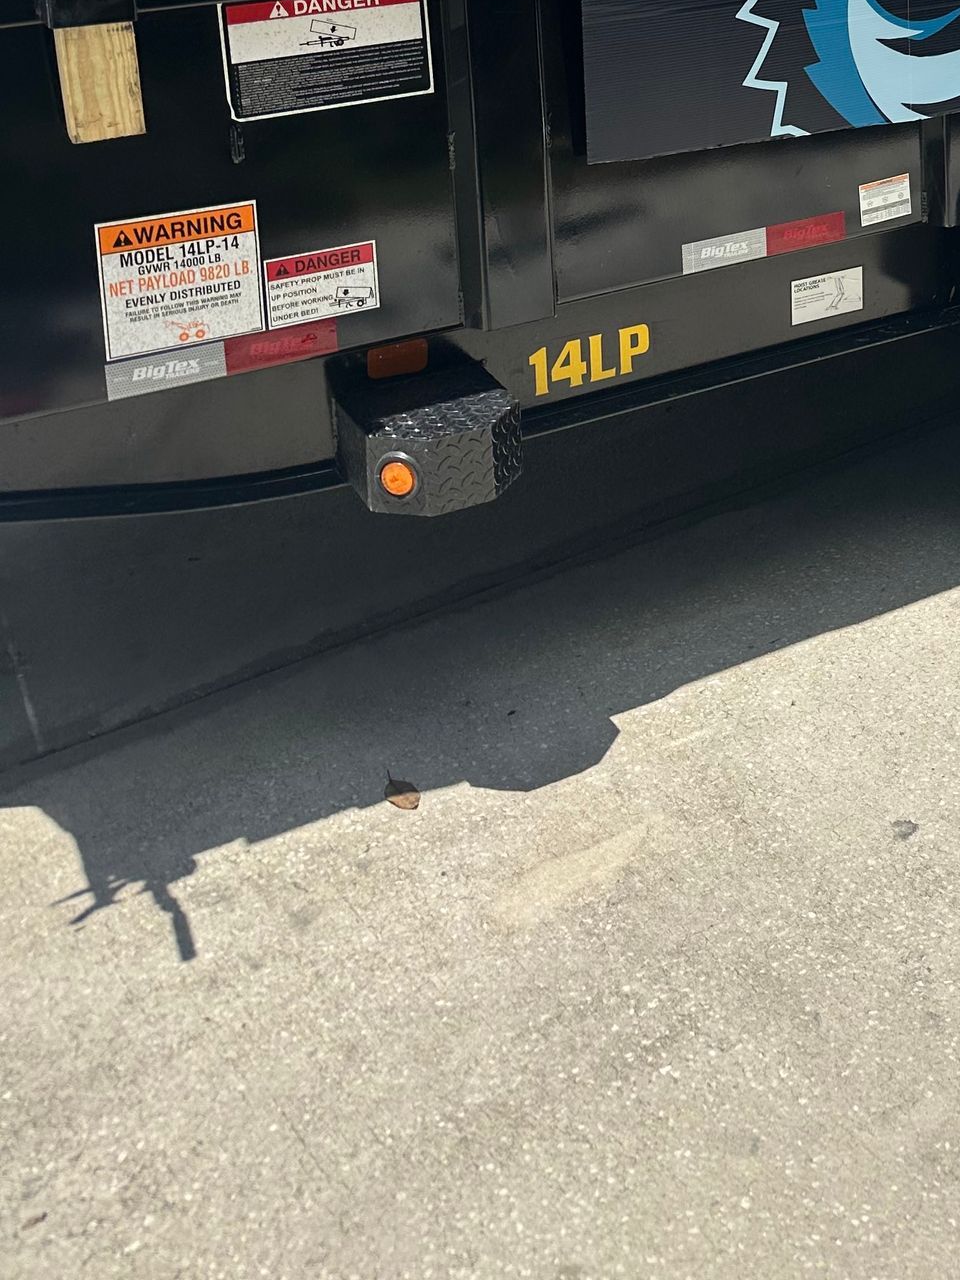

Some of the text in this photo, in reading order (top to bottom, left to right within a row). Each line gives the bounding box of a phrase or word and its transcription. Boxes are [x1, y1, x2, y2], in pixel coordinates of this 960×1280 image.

[133, 212, 242, 245] WARNING
[120, 235, 240, 268] MODEL 14LP-14
[295, 249, 361, 273] DANGER
[700, 240, 749, 259] BigTex
[138, 262, 171, 276] GVWR
[174, 255, 205, 270] 14000
[109, 279, 134, 298] NET
[138, 271, 196, 293] PAYLOAD
[200, 263, 230, 282] 9820
[270, 280, 299, 291] SAFETY
[301, 275, 322, 285] PROP
[323, 271, 343, 281] MUST
[346, 268, 356, 276] BE
[125, 280, 241, 309] EVENLY DISTRIBUTED
[125, 309, 150, 318] FAILURE
[160, 302, 185, 312] FOLLOW
[186, 299, 199, 307] THIS
[201, 295, 228, 304] WARNING
[271, 287, 317, 302] UP POSITION
[271, 295, 334, 312] BEFORE WORKING
[129, 314, 152, 323] RESULT
[162, 308, 187, 318] SERIOUS
[188, 304, 209, 312] INJURY
[220, 299, 239, 307] DEATH
[272, 311, 299, 323] UNDER
[132, 358, 200, 382] BigTex
[528, 322, 650, 397] 14LP
